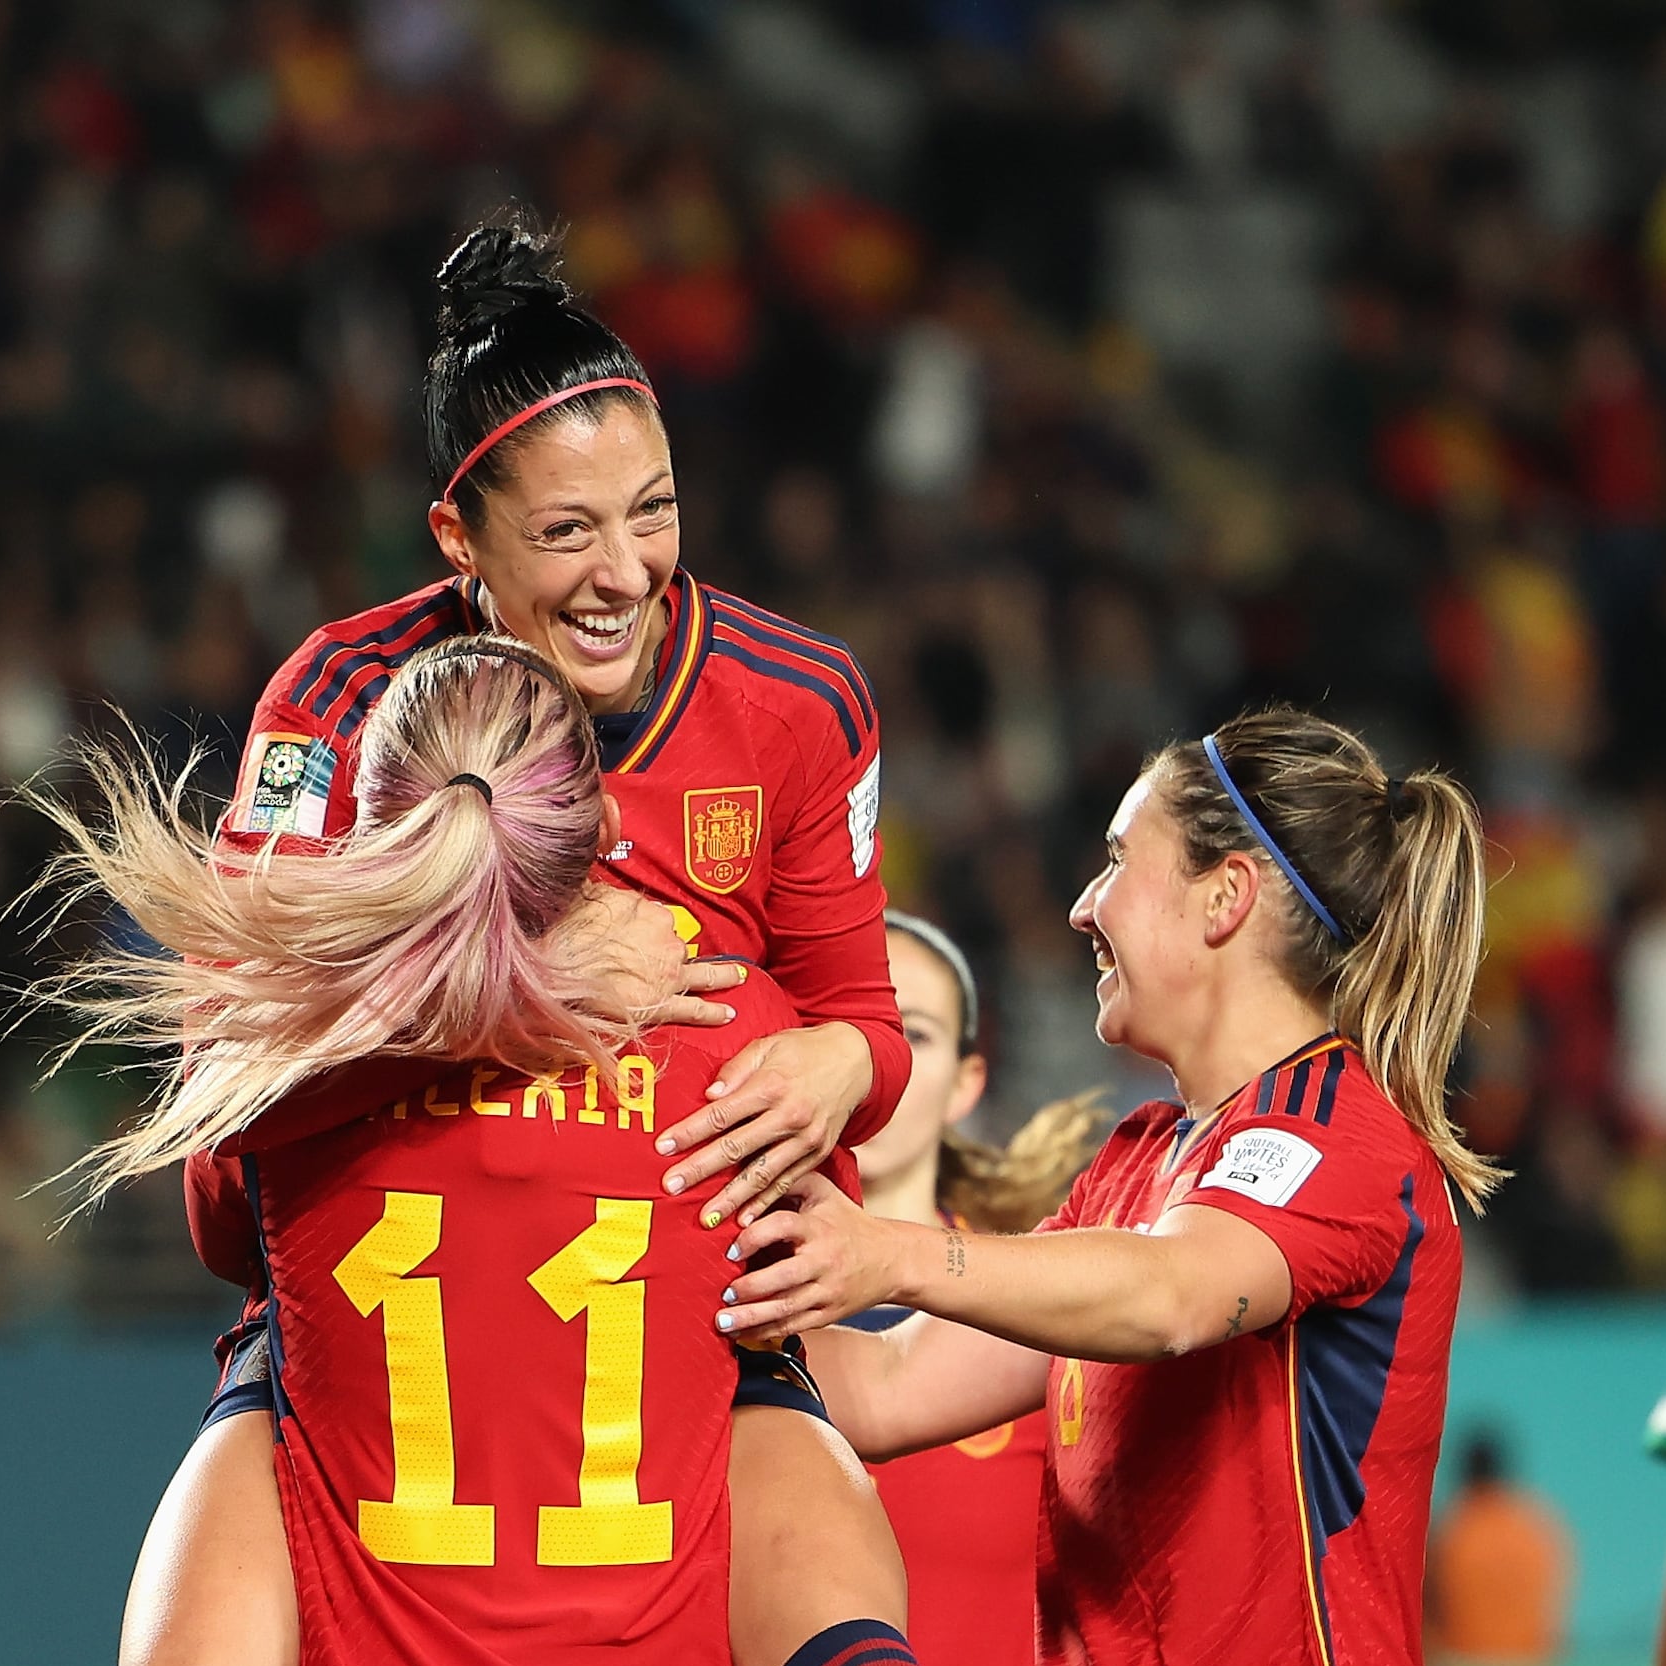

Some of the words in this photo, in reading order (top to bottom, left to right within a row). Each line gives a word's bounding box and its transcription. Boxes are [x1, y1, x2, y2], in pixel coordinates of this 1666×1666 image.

[391, 1055, 655, 1133] LEXIA
[1234, 1148, 1288, 1168] UNITES
[332, 1191, 674, 1567] 11
